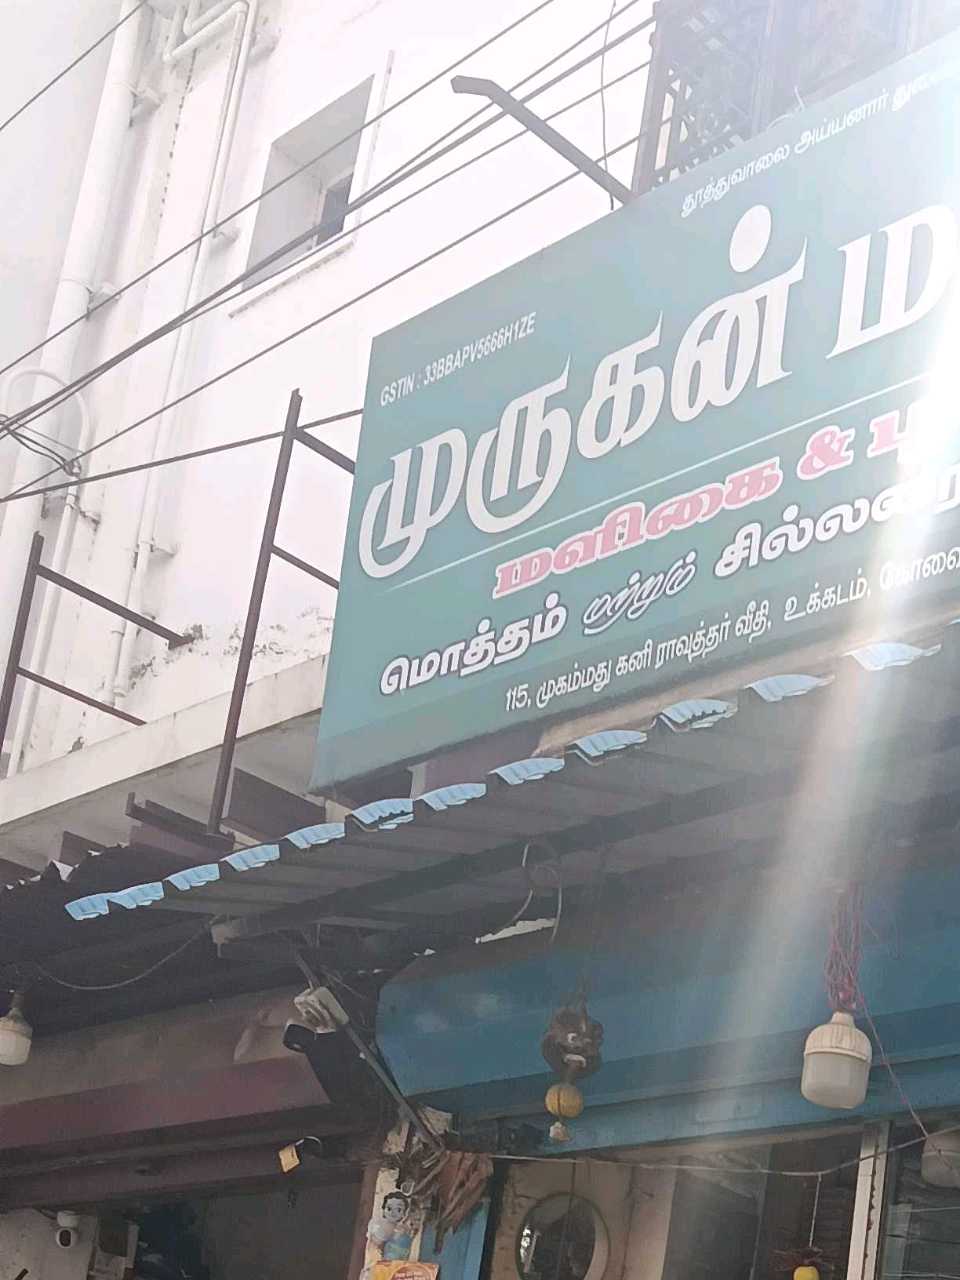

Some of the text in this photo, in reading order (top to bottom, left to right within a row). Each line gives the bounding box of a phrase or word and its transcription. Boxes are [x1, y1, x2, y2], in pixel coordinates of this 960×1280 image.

[358, 204, 809, 580] முருகன்
[380, 373, 415, 407] GSTIN
[493, 456, 784, 599] மளிகை
[797, 425, 856, 480] &
[380, 592, 568, 694] மொத்தம்
[583, 551, 697, 635] மற்றும்
[505, 683, 531, 711] 115,
[536, 663, 612, 709] முகம்மது
[616, 639, 653, 676] கனி
[654, 611, 730, 670] ராவுத்தர்
[735, 600, 772, 643] வீதி,
[783, 568, 871, 622] உக்கடம்,
